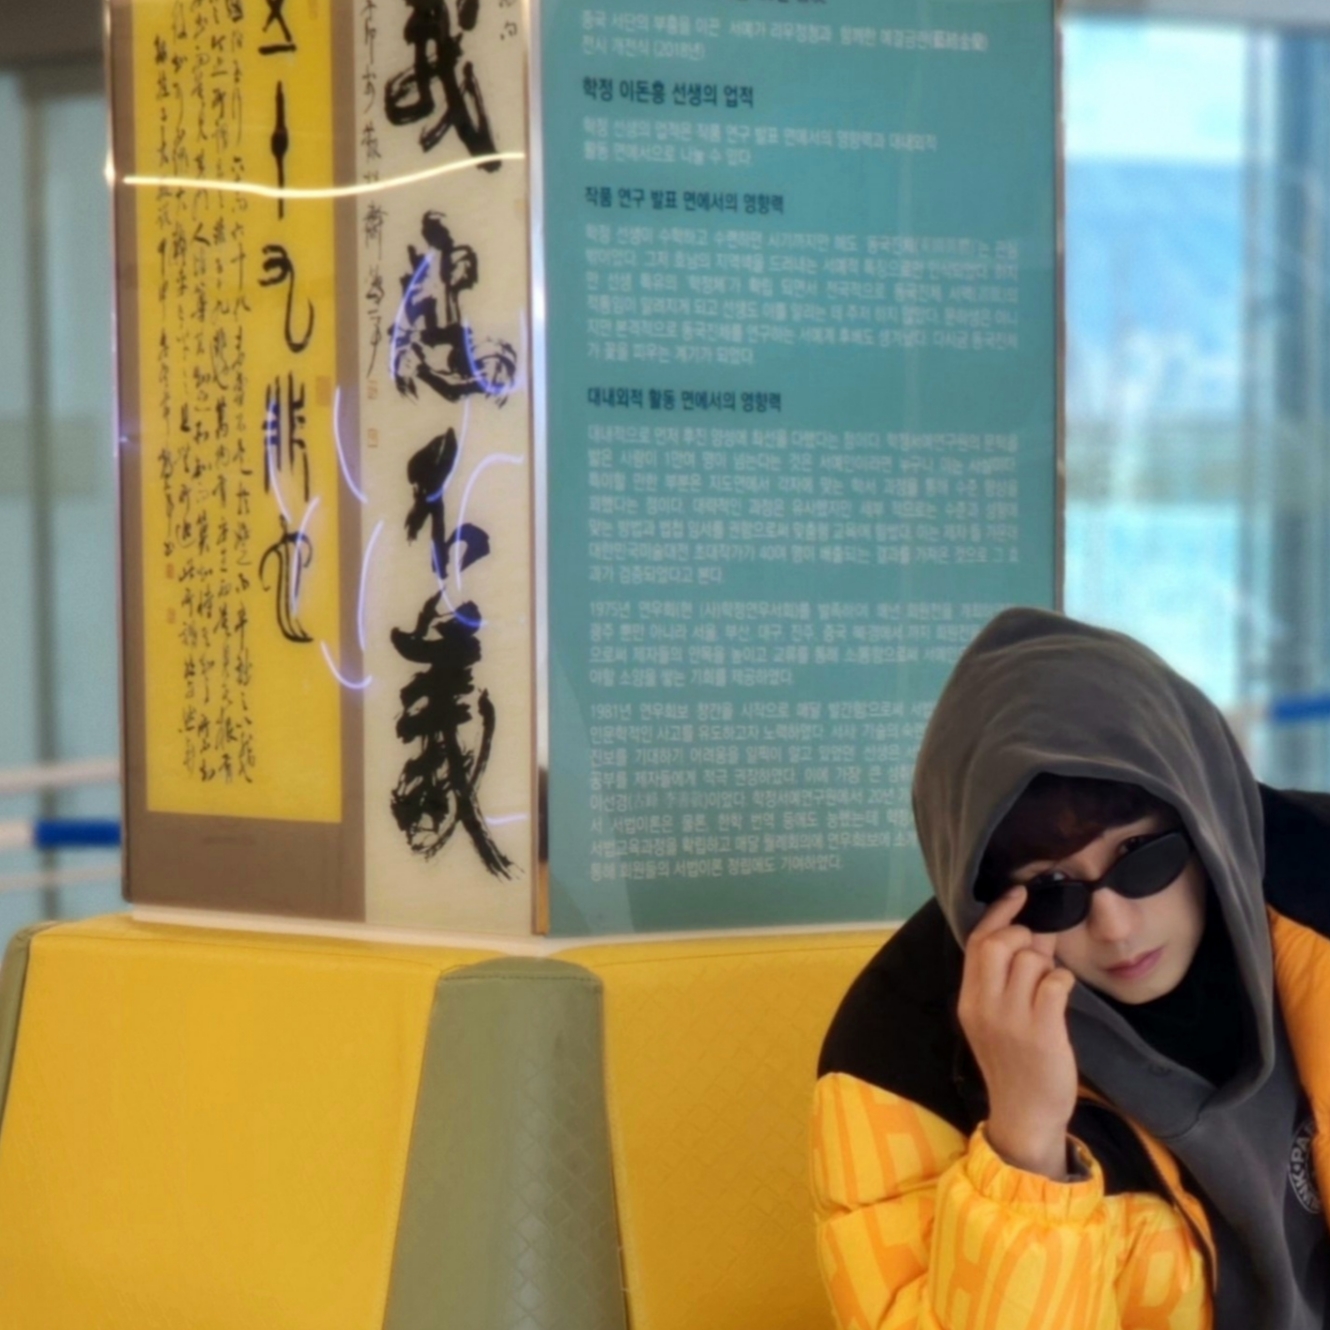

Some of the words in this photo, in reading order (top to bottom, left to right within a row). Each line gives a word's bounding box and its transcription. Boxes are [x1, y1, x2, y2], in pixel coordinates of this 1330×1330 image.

[583, 77, 613, 101] 학정
[619, 79, 665, 104] 이돈흥
[672, 82, 717, 107] 선생의
[723, 85, 754, 109] 업적
[585, 186, 611, 207] 작품
[618, 187, 644, 209] 연구
[651, 190, 677, 210] 발표
[683, 191, 737, 212] 면에서의
[743, 193, 783, 215] 영향력
[588, 387, 643, 407] 대내외적
[649, 389, 676, 410] 활동
[681, 391, 736, 411] 면에서의
[741, 392, 782, 413] 영향력
